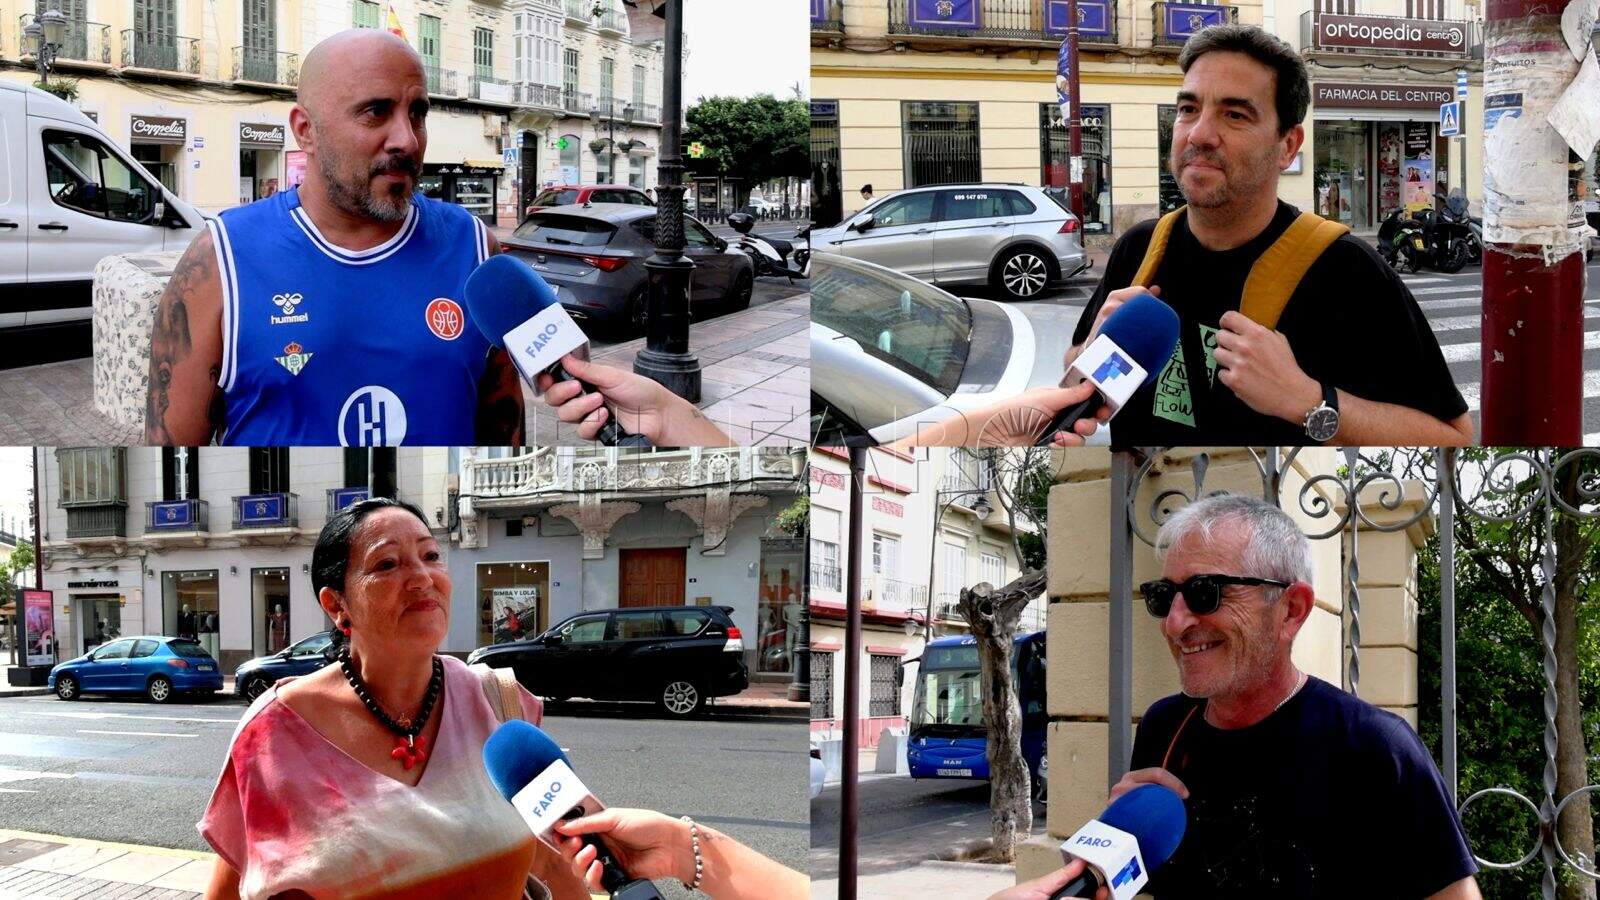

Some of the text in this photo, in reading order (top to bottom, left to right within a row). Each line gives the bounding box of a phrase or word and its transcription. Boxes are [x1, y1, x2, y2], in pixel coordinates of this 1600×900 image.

[1325, 23, 1421, 44] ortopedia
[1319, 88, 1451, 103] FARMACIA DEL CENTRO
[132, 119, 185, 136] Coppelia
[241, 126, 284, 141] Coppelia
[270, 312, 309, 325] hummel
[525, 323, 558, 358] FARO
[532, 781, 562, 818] FARO
[1076, 835, 1112, 848] FARO
